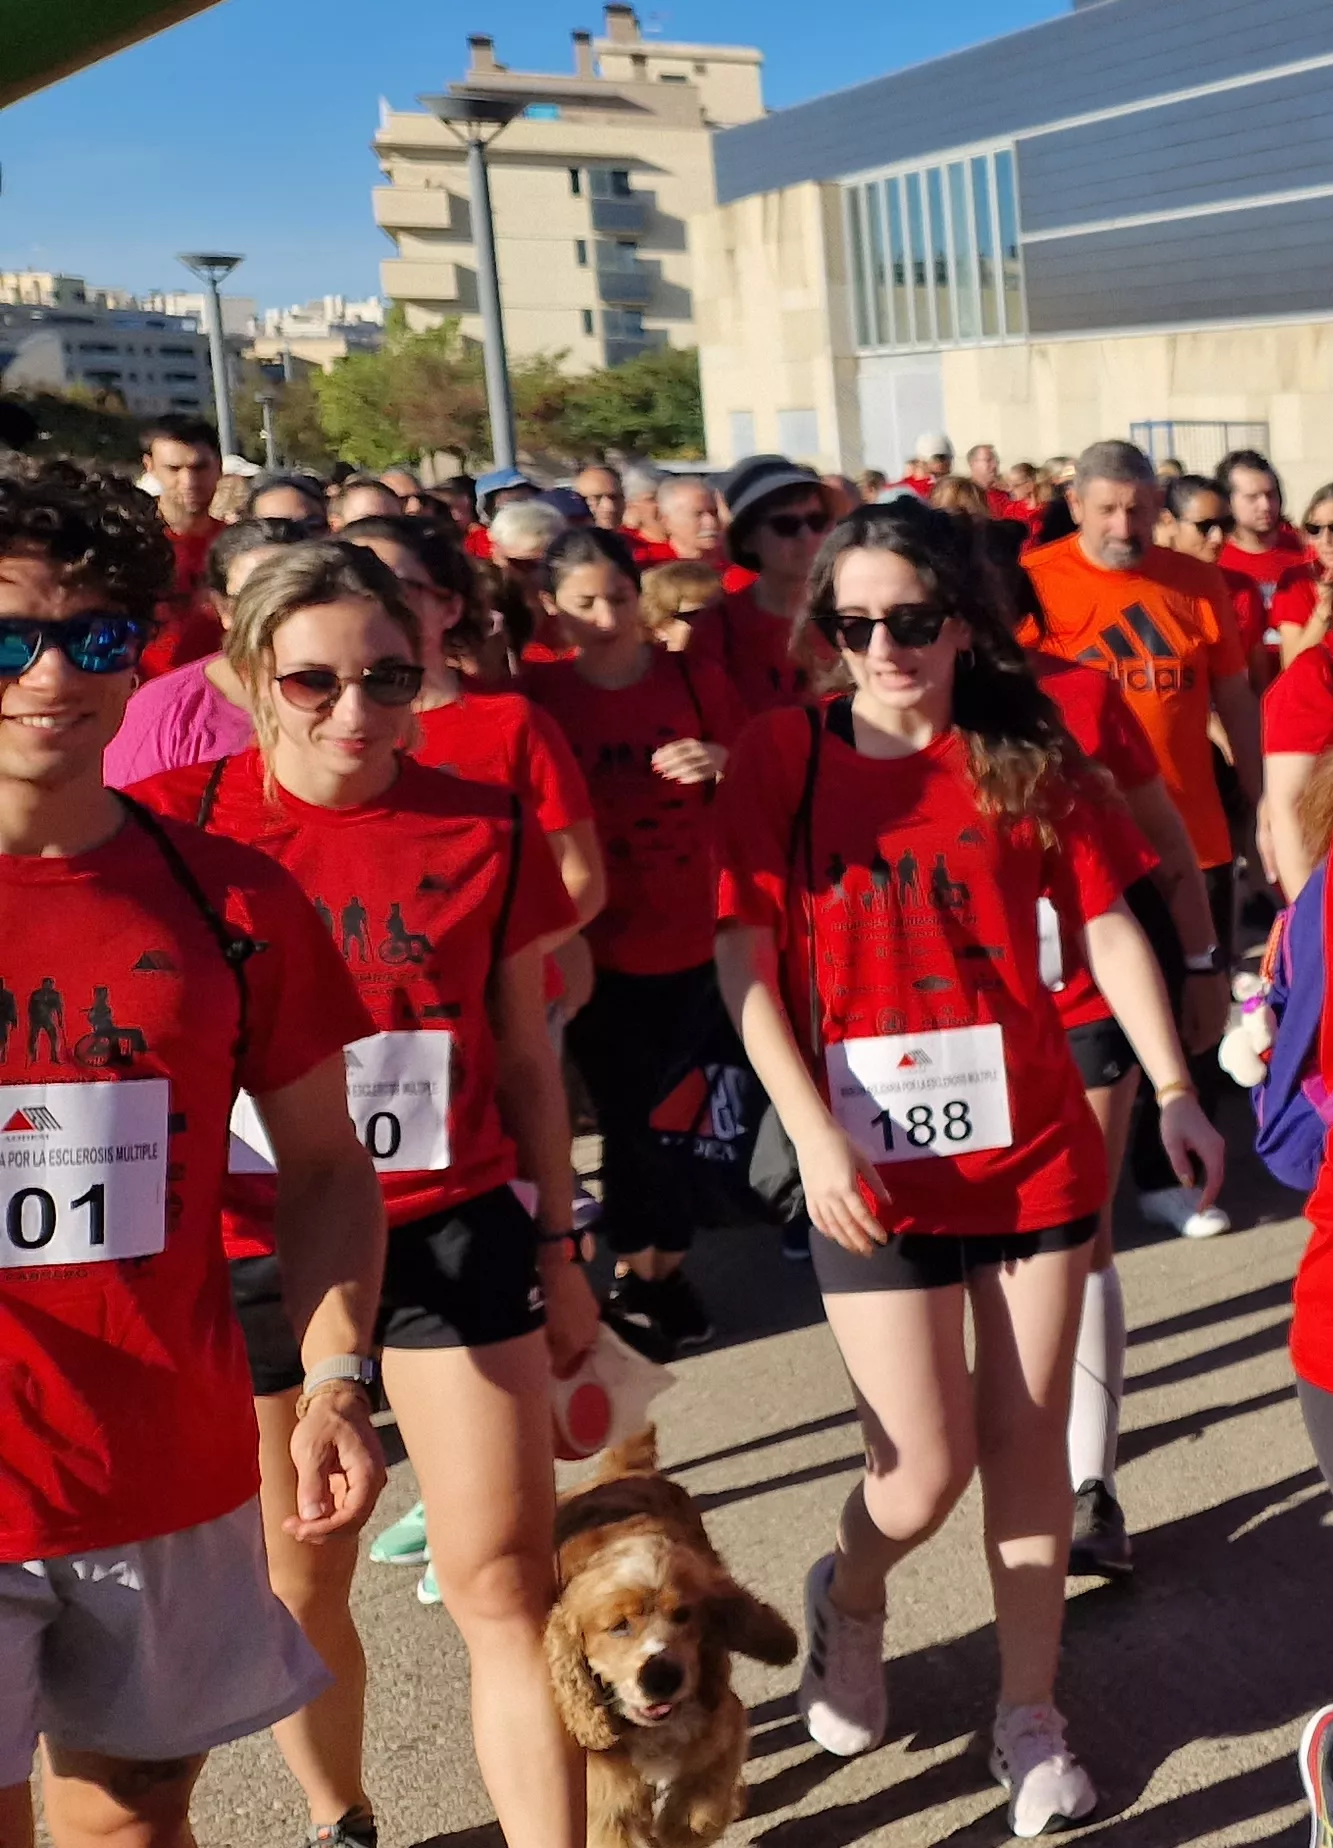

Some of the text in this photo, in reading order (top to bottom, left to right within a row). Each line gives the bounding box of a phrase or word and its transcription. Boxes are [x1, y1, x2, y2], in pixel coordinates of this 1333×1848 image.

[871, 1100, 973, 1152] 188
[8, 1150, 30, 1168] POR
[33, 1149, 46, 1168] LA
[49, 1146, 114, 1167] ESCLEROSIS
